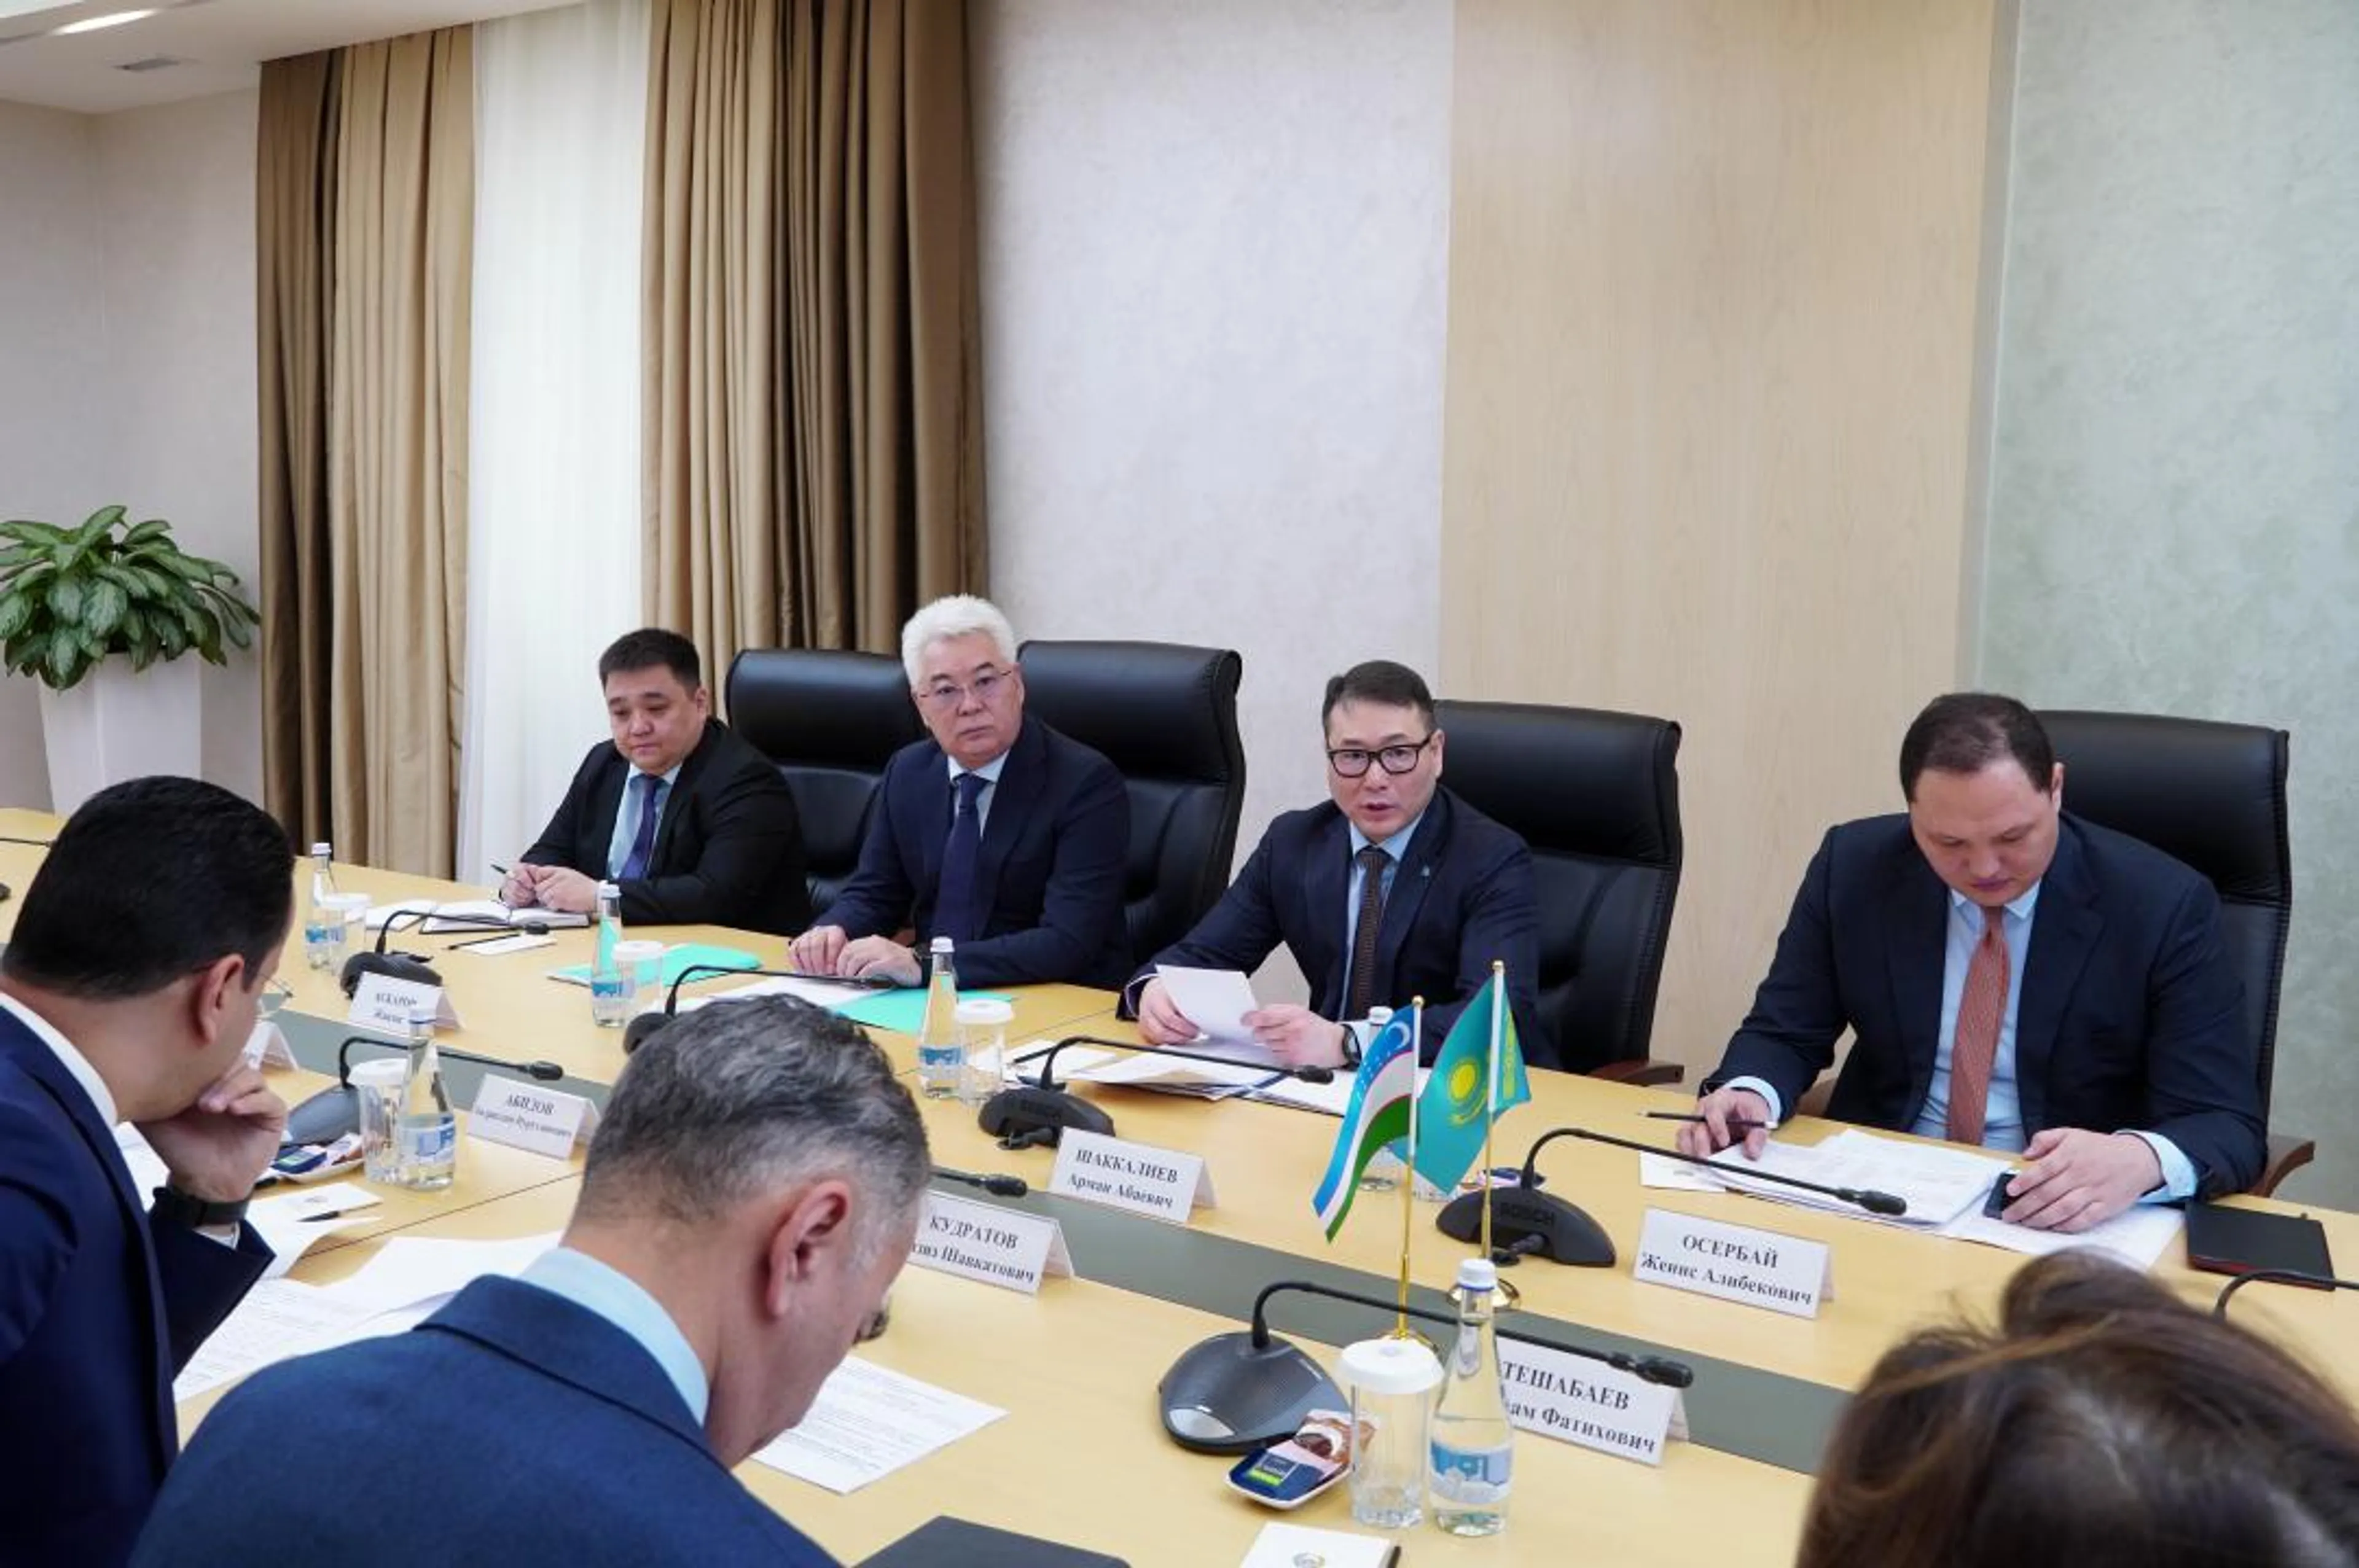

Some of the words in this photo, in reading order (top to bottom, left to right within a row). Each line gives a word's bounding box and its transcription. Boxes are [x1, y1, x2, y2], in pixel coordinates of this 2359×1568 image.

[1068, 1174, 1113, 1195] Арман
[1075, 1149, 1178, 1184] ШАККАЛИЕВ
[929, 1215, 1019, 1249] КУДРАТОВ
[941, 1246, 1035, 1284] Шавкатович
[1682, 1233, 1778, 1268] ОСЕРБАЙ
[1641, 1252, 1697, 1279] Женис
[1702, 1268, 1812, 1305] Алибекович
[1502, 1360, 1630, 1410] ТЕШАБАЕВ
[1542, 1408, 1656, 1454] Фатихович
